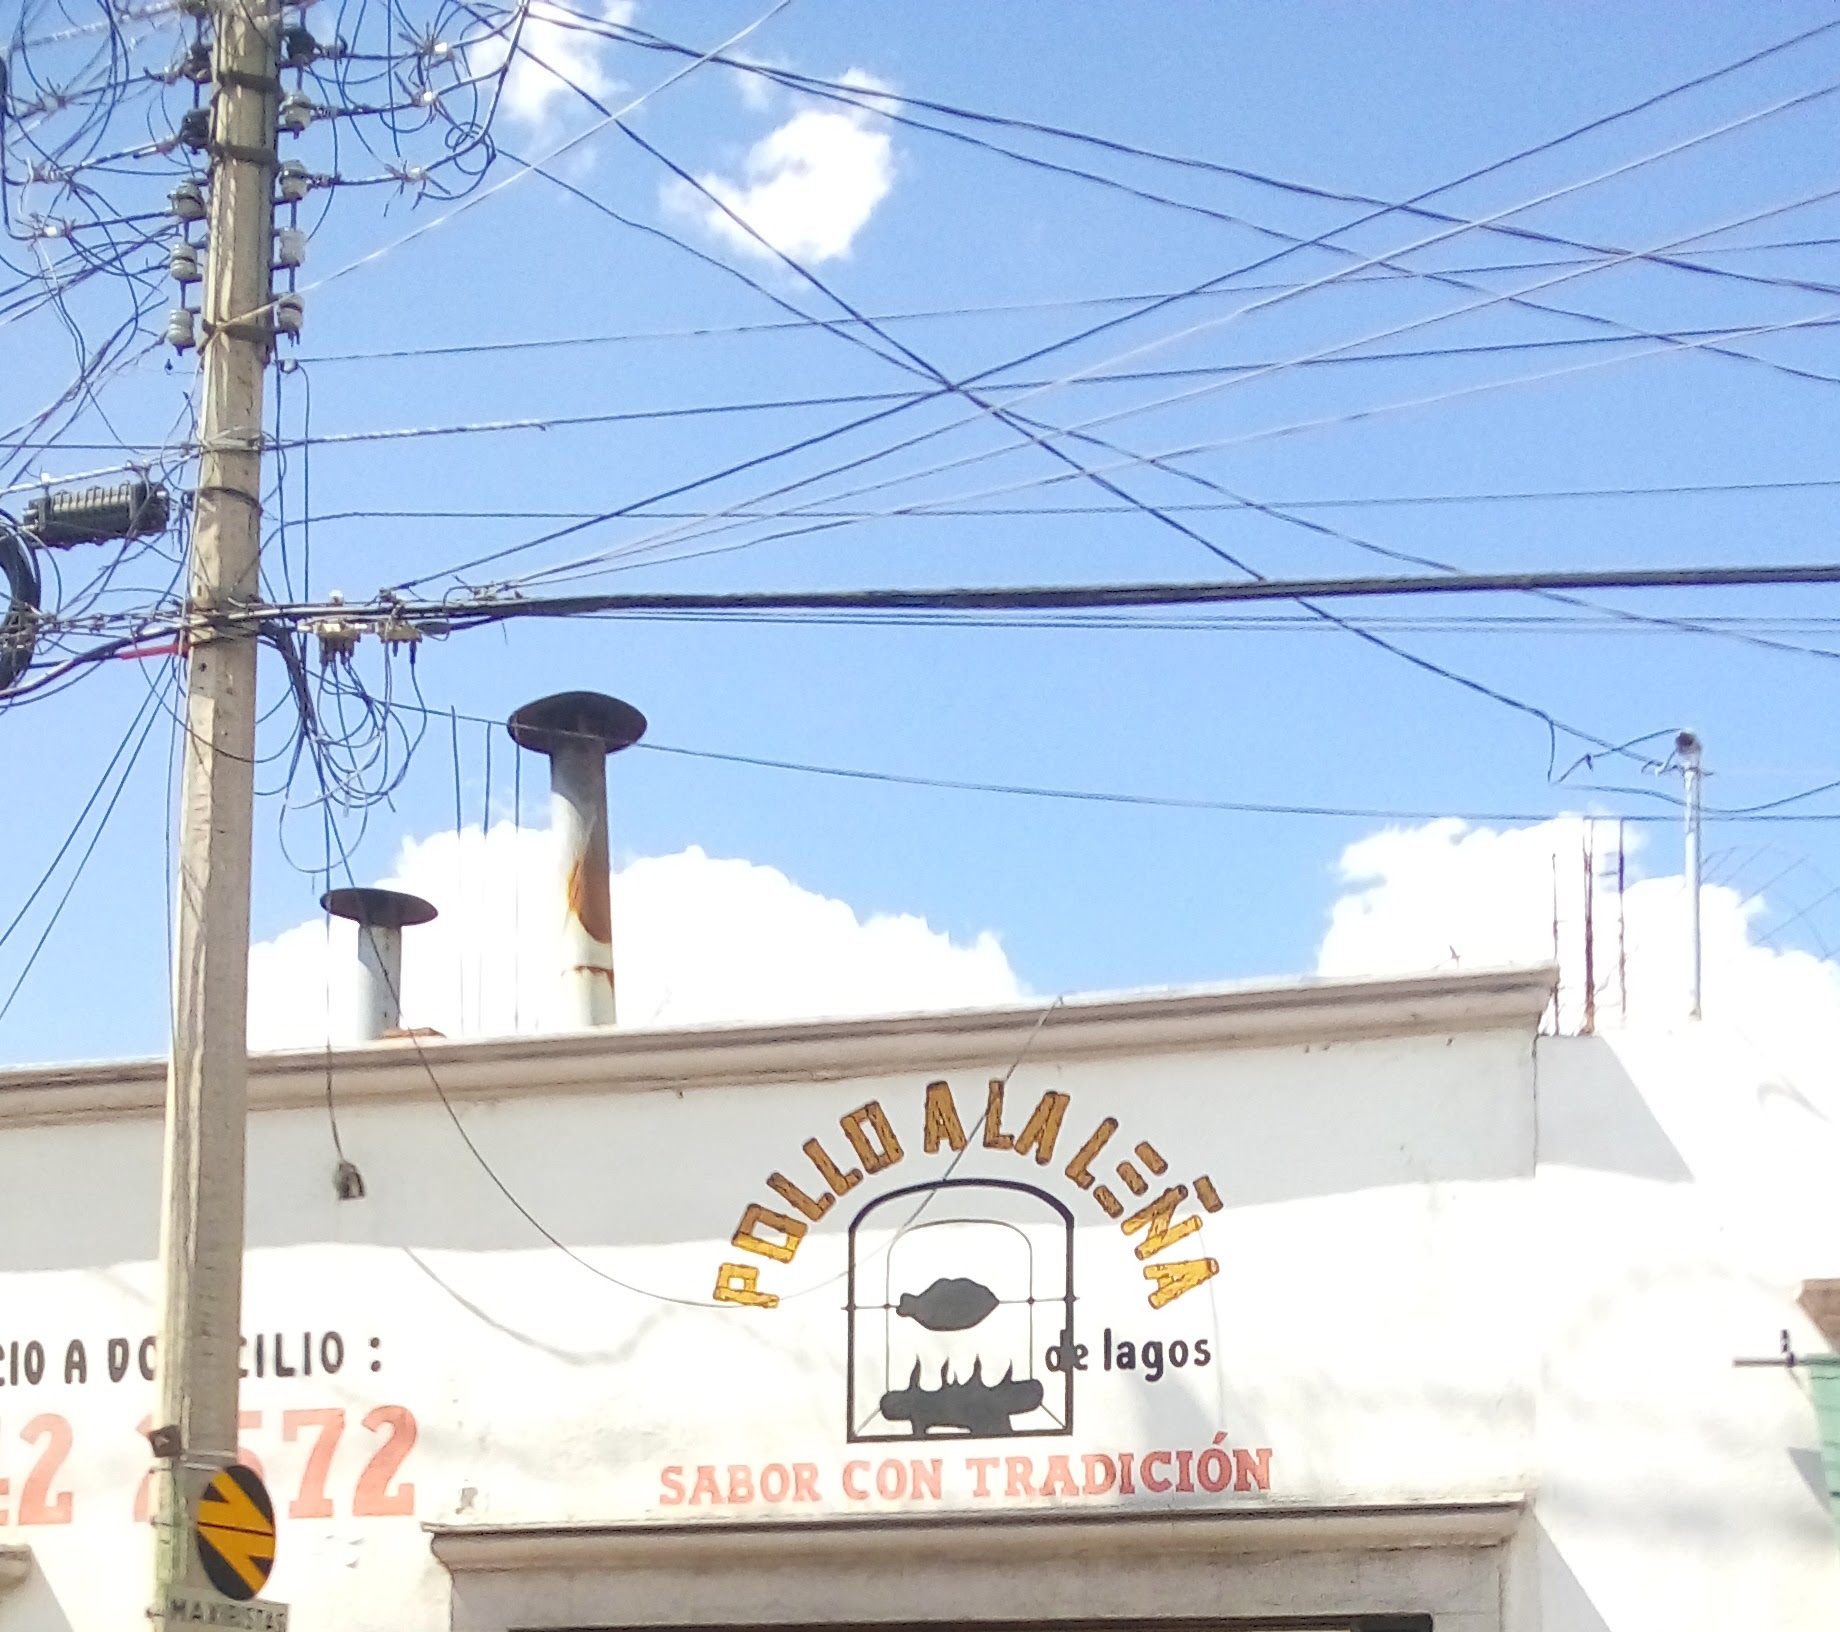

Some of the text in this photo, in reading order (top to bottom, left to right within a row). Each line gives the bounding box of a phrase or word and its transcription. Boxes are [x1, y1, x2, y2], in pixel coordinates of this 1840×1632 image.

[713, 1079, 1221, 1310] POLLO A LA LEÑA
[0, 1340, 45, 1387] IO
[64, 1338, 87, 1384] A
[1045, 1327, 1212, 1382] de lagos
[660, 1431, 1274, 1506] SABOR CON TRADICIÓN
